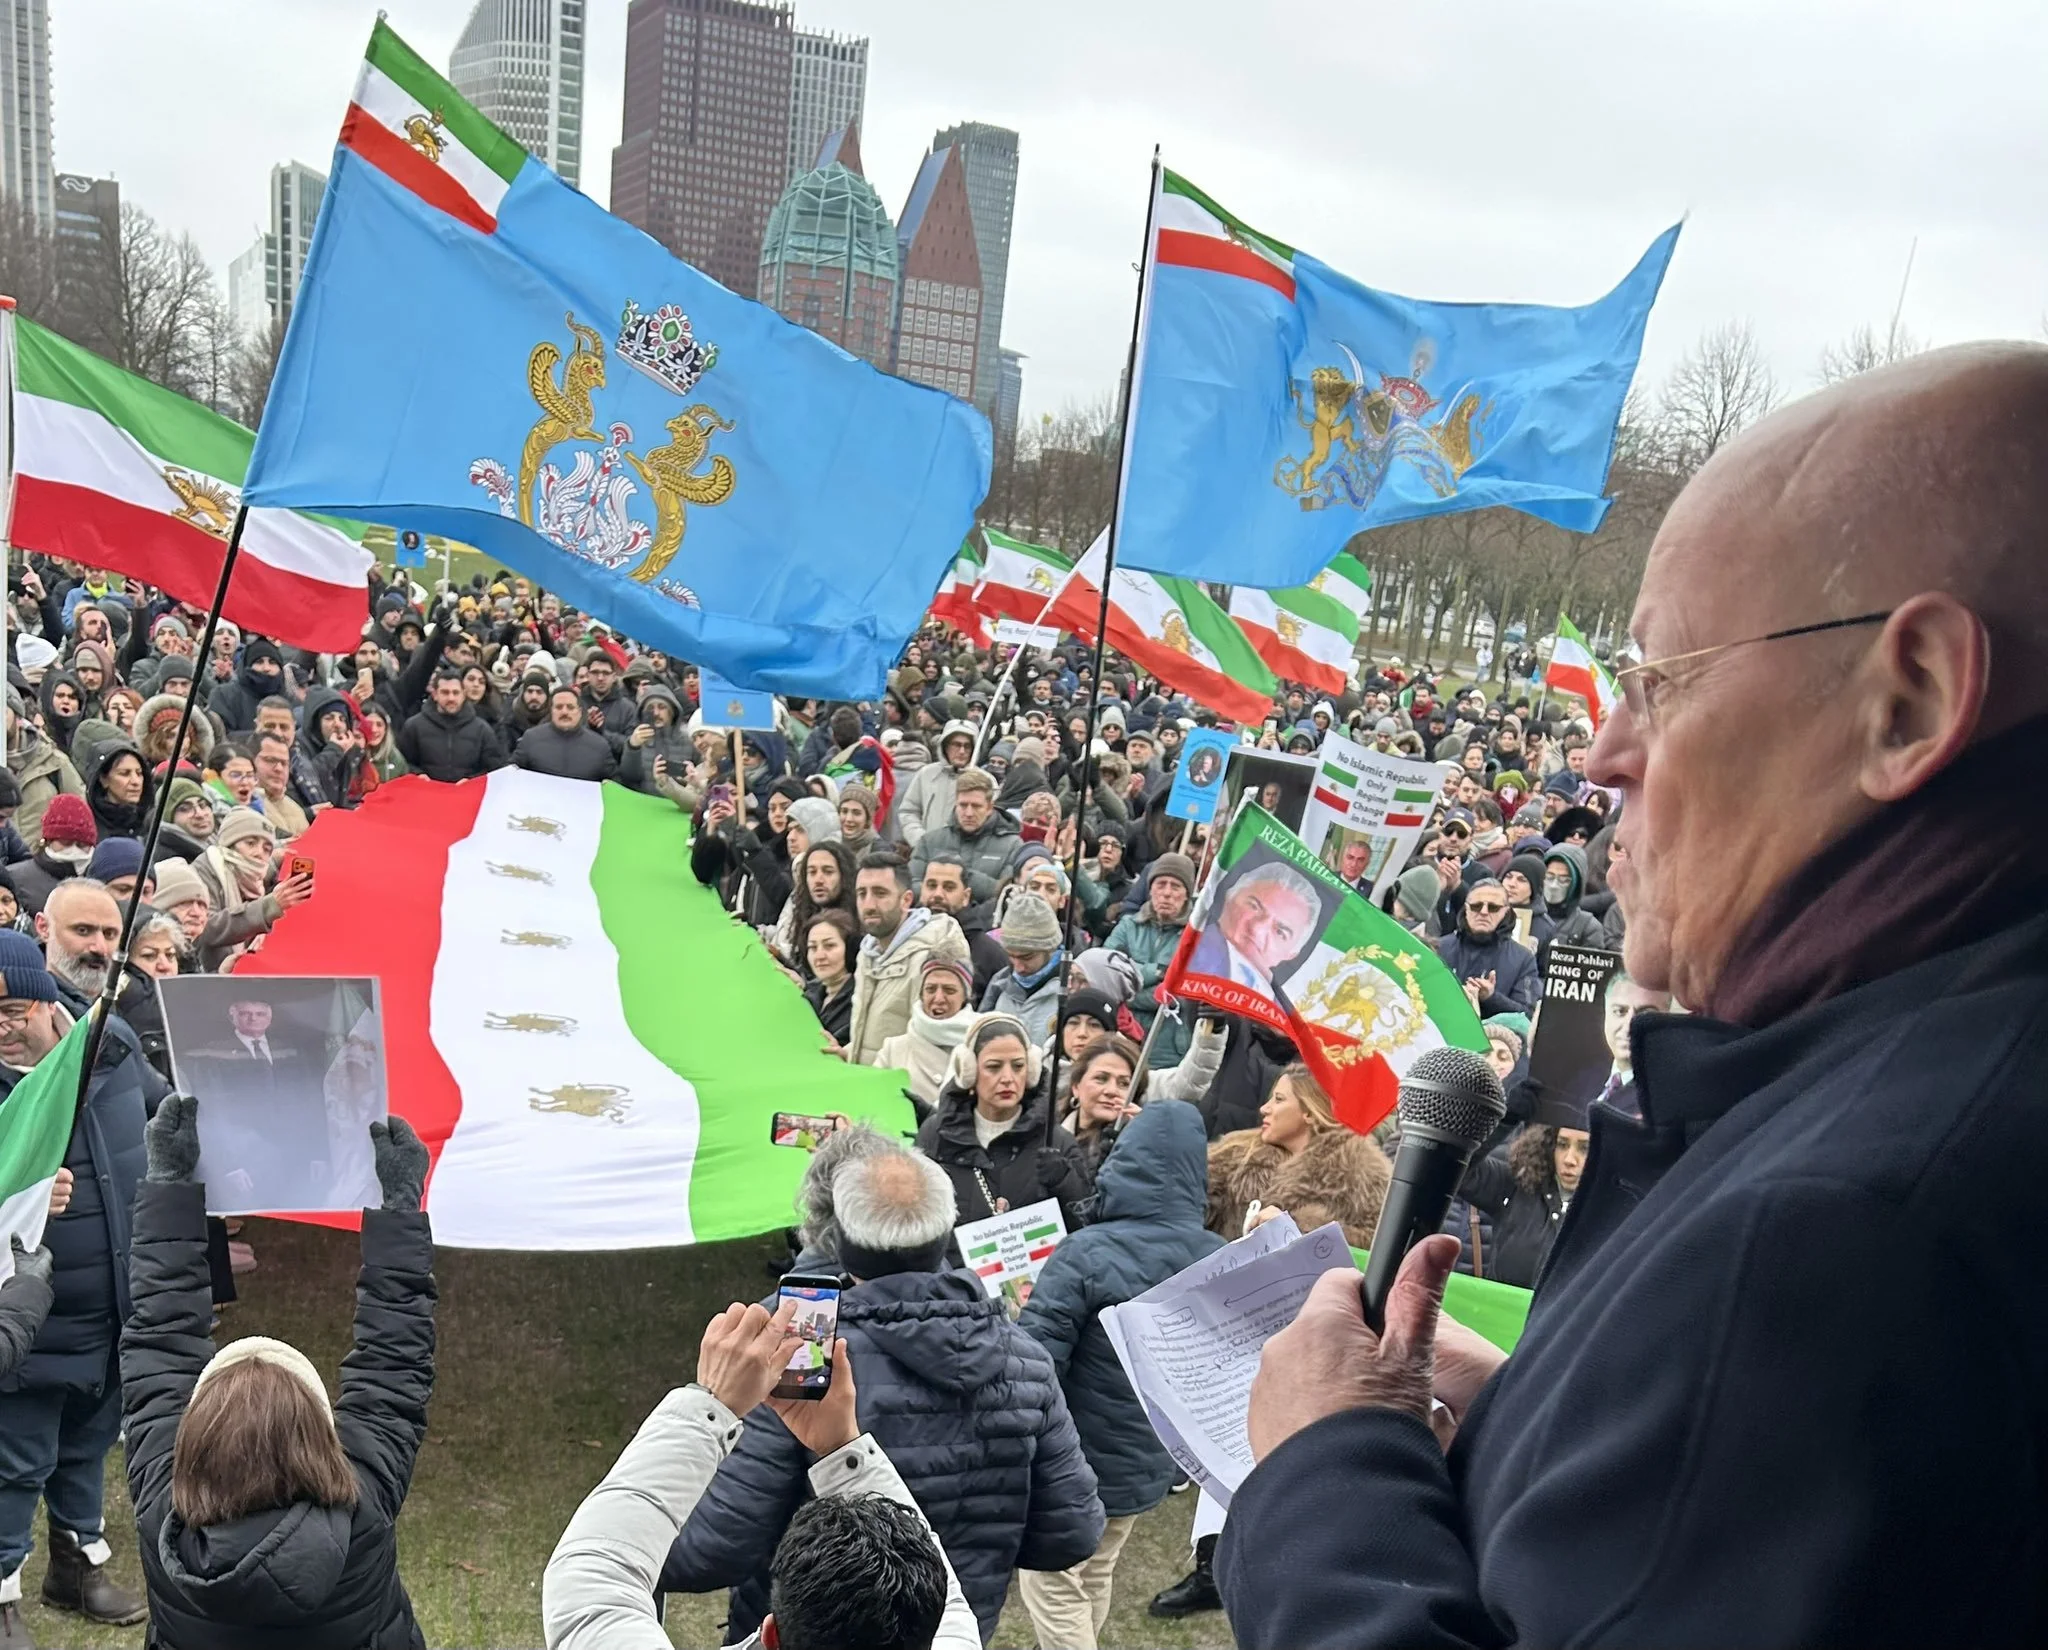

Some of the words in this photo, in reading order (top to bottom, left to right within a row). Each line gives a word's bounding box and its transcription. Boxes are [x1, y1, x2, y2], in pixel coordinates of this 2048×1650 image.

[1337, 752, 1349, 763] No
[1349, 759, 1384, 777] Islamic
[1385, 770, 1428, 785] Republic
[1366, 779, 1388, 793] Only
[1356, 789, 1389, 805] Regime
[1352, 801, 1385, 816] Change
[1351, 814, 1360, 823] in
[1360, 817, 1378, 828] Iran
[1259, 824, 1295, 857] REZA
[1550, 950, 1575, 962] Reza
[1577, 954, 1614, 968] Pahlavi
[1548, 964, 1581, 978] KING
[1587, 969, 1604, 980] OF
[1545, 977, 1596, 1003] IRAN
[1180, 979, 1223, 998] KING
[1224, 990, 1250, 1005] OF
[1248, 998, 1288, 1025] IRAN
[983, 1226, 1009, 1238] Islamic
[1009, 1215, 1043, 1230] Republic
[1002, 1235, 1017, 1243] Only
[1001, 1243, 1024, 1254] Regime
[1003, 1252, 1027, 1264] Change
[1015, 1262, 1028, 1271] Iran
